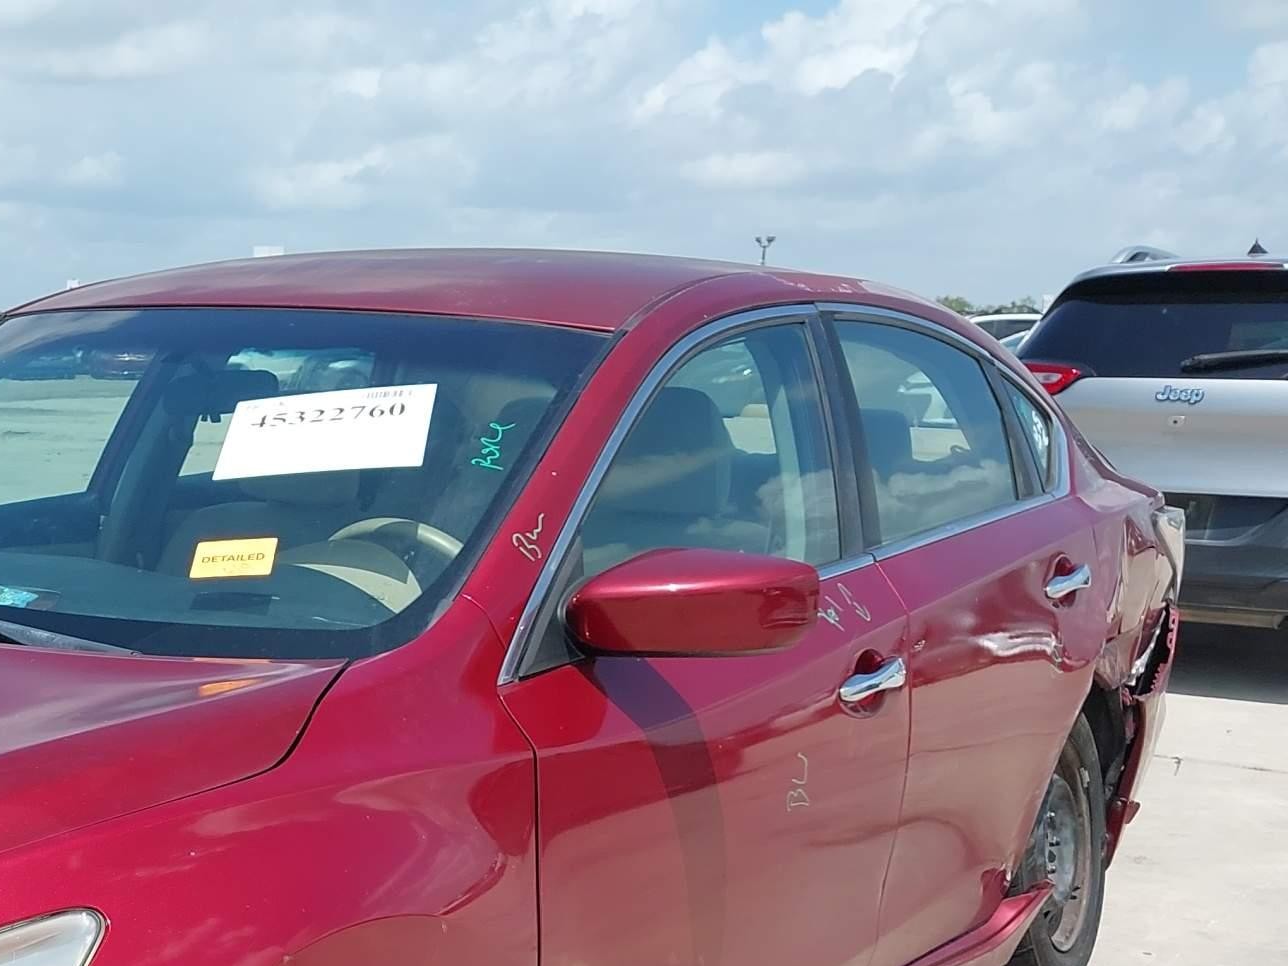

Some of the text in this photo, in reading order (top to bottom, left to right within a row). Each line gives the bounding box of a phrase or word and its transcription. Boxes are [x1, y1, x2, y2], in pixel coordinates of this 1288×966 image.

[1155, 385, 1205, 405] Jeep
[250, 402, 406, 428] 45322760
[201, 552, 266, 564] DETAILED
